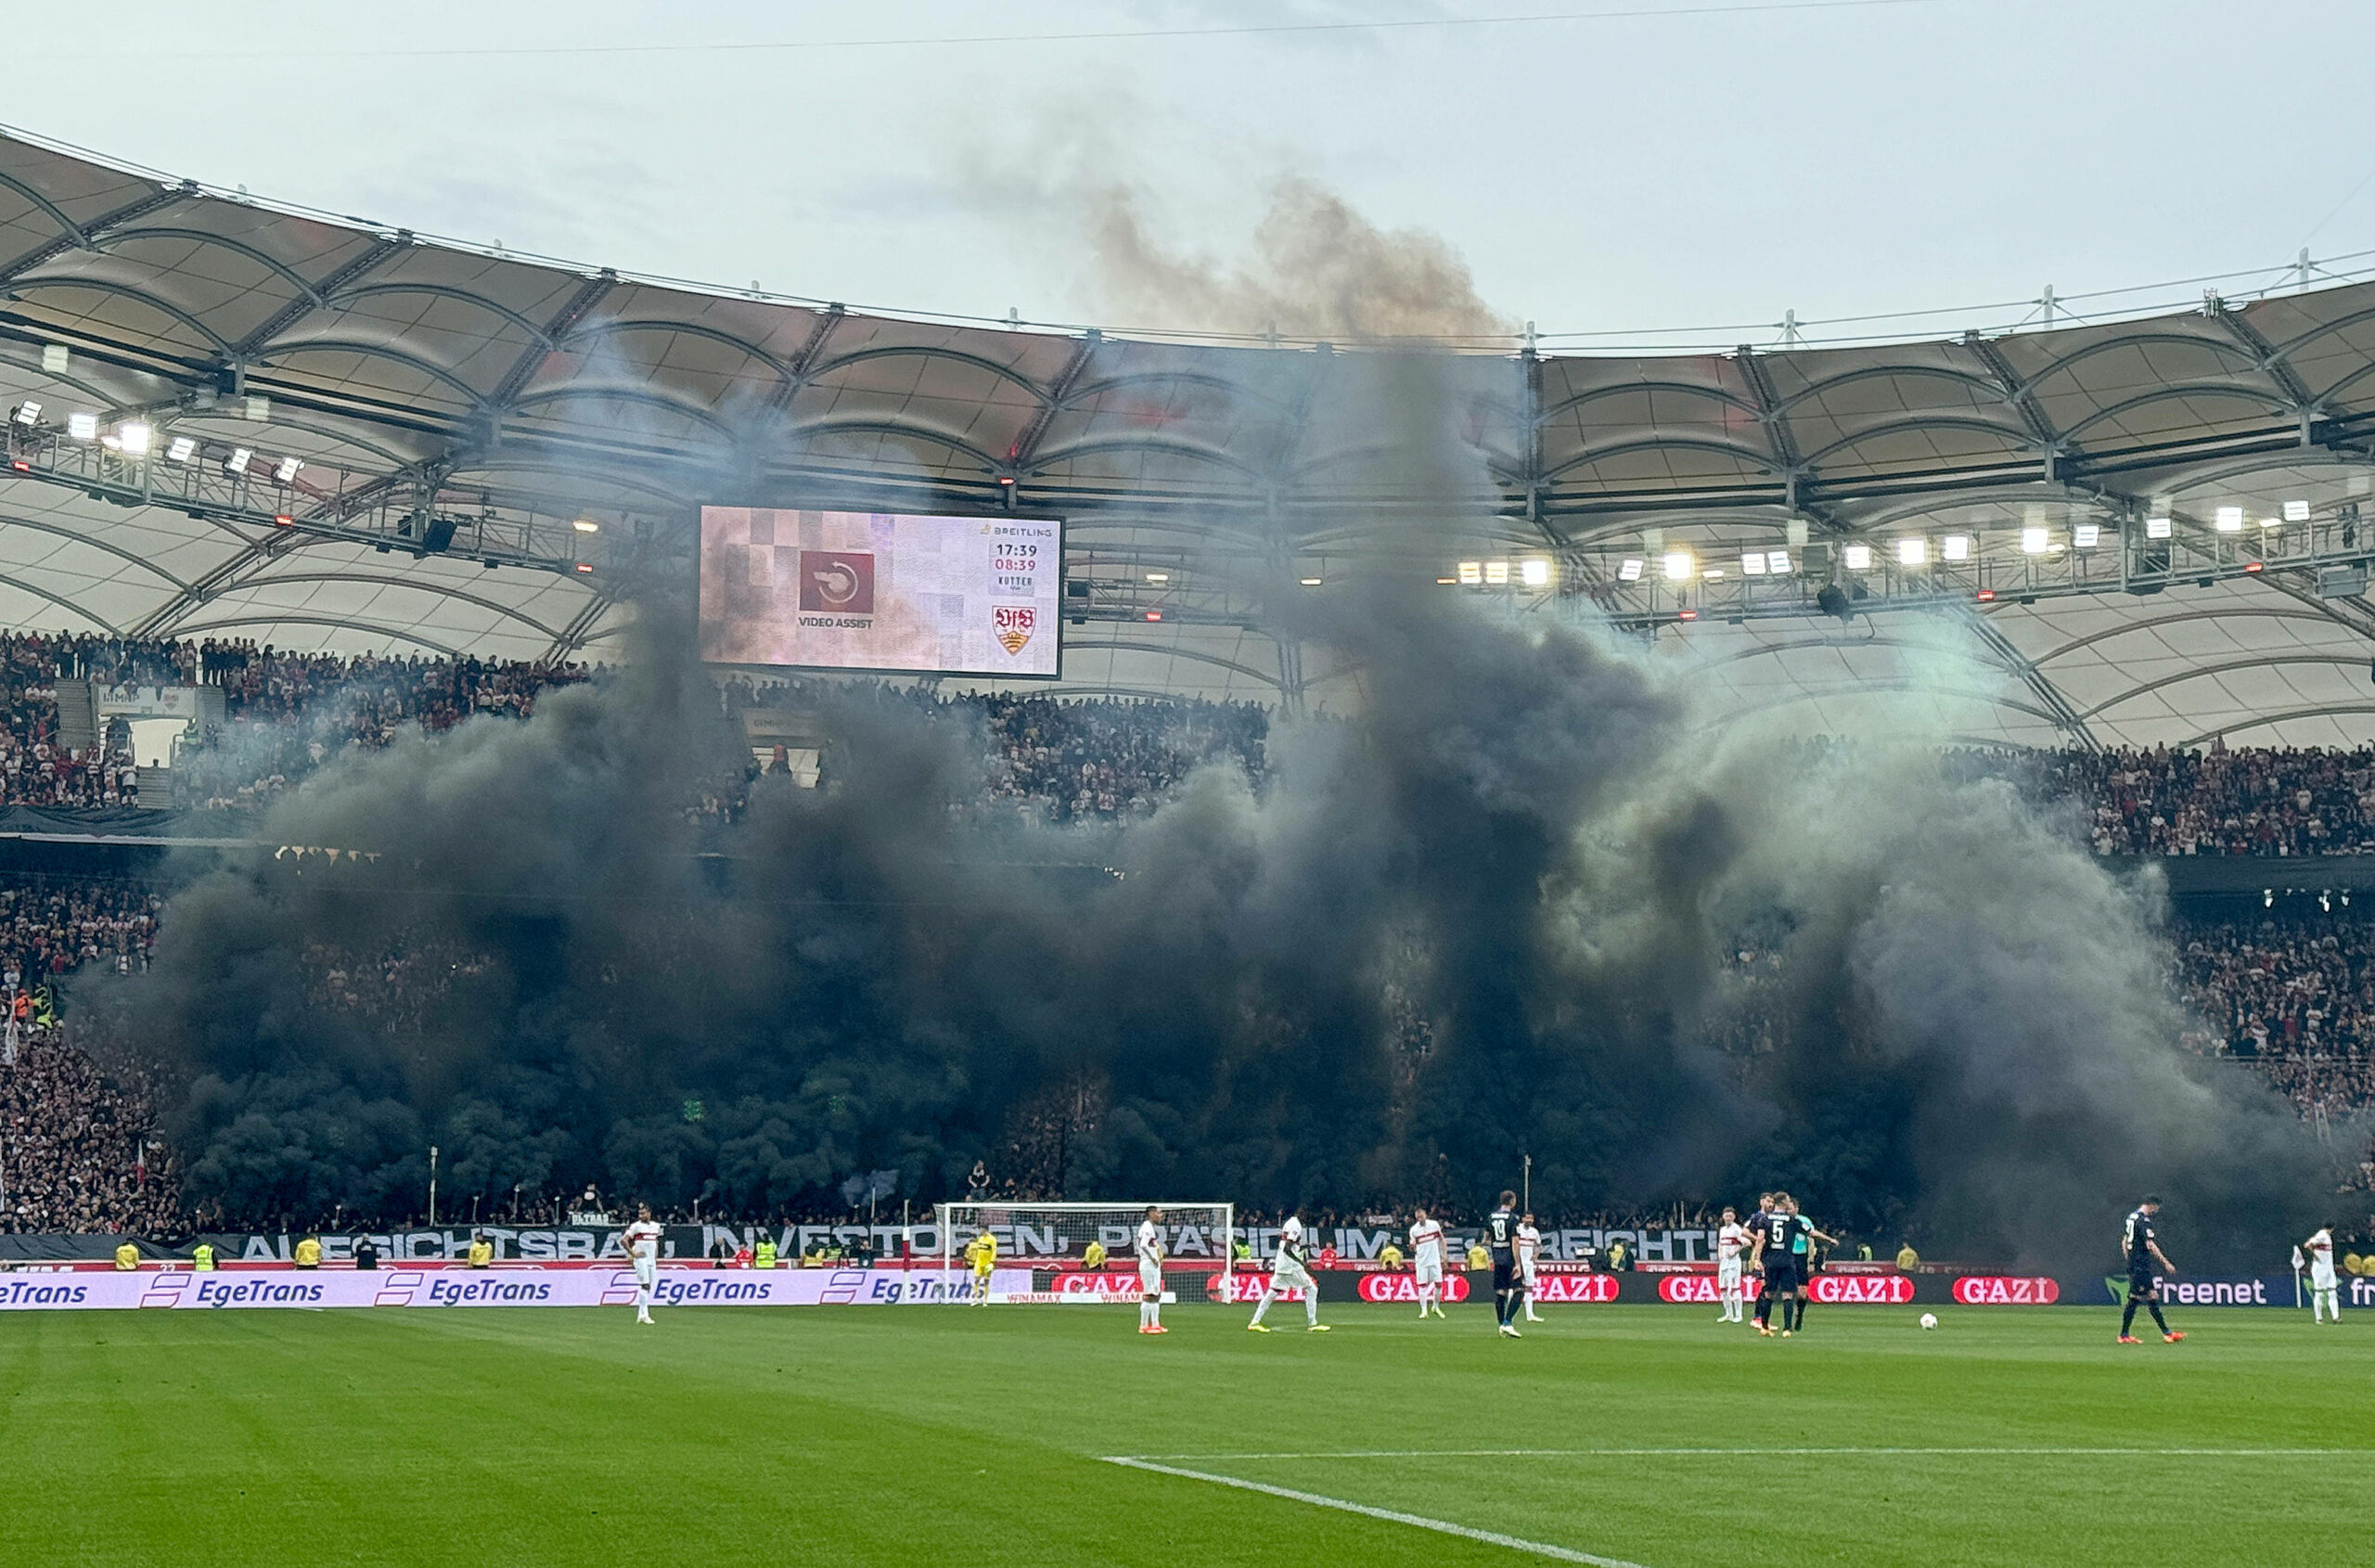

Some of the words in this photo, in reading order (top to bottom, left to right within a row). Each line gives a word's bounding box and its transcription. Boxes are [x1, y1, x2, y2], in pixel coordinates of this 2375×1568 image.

[994, 527, 1052, 537] BREITLING
[997, 544, 1037, 557] 17:39
[995, 559, 1036, 571] 08:39
[798, 616, 834, 627] VIDEO
[835, 618, 874, 629] ASSIST
[1492, 1219, 1507, 1241] 19
[1772, 1220, 1784, 1242] 5
[1063, 1275, 1136, 1292] GAZ
[197, 1279, 324, 1307] EgeTrans
[430, 1279, 551, 1306] EgeTrans
[654, 1279, 772, 1306] EgeTrans
[1101, 1293, 1143, 1304] WINAM
